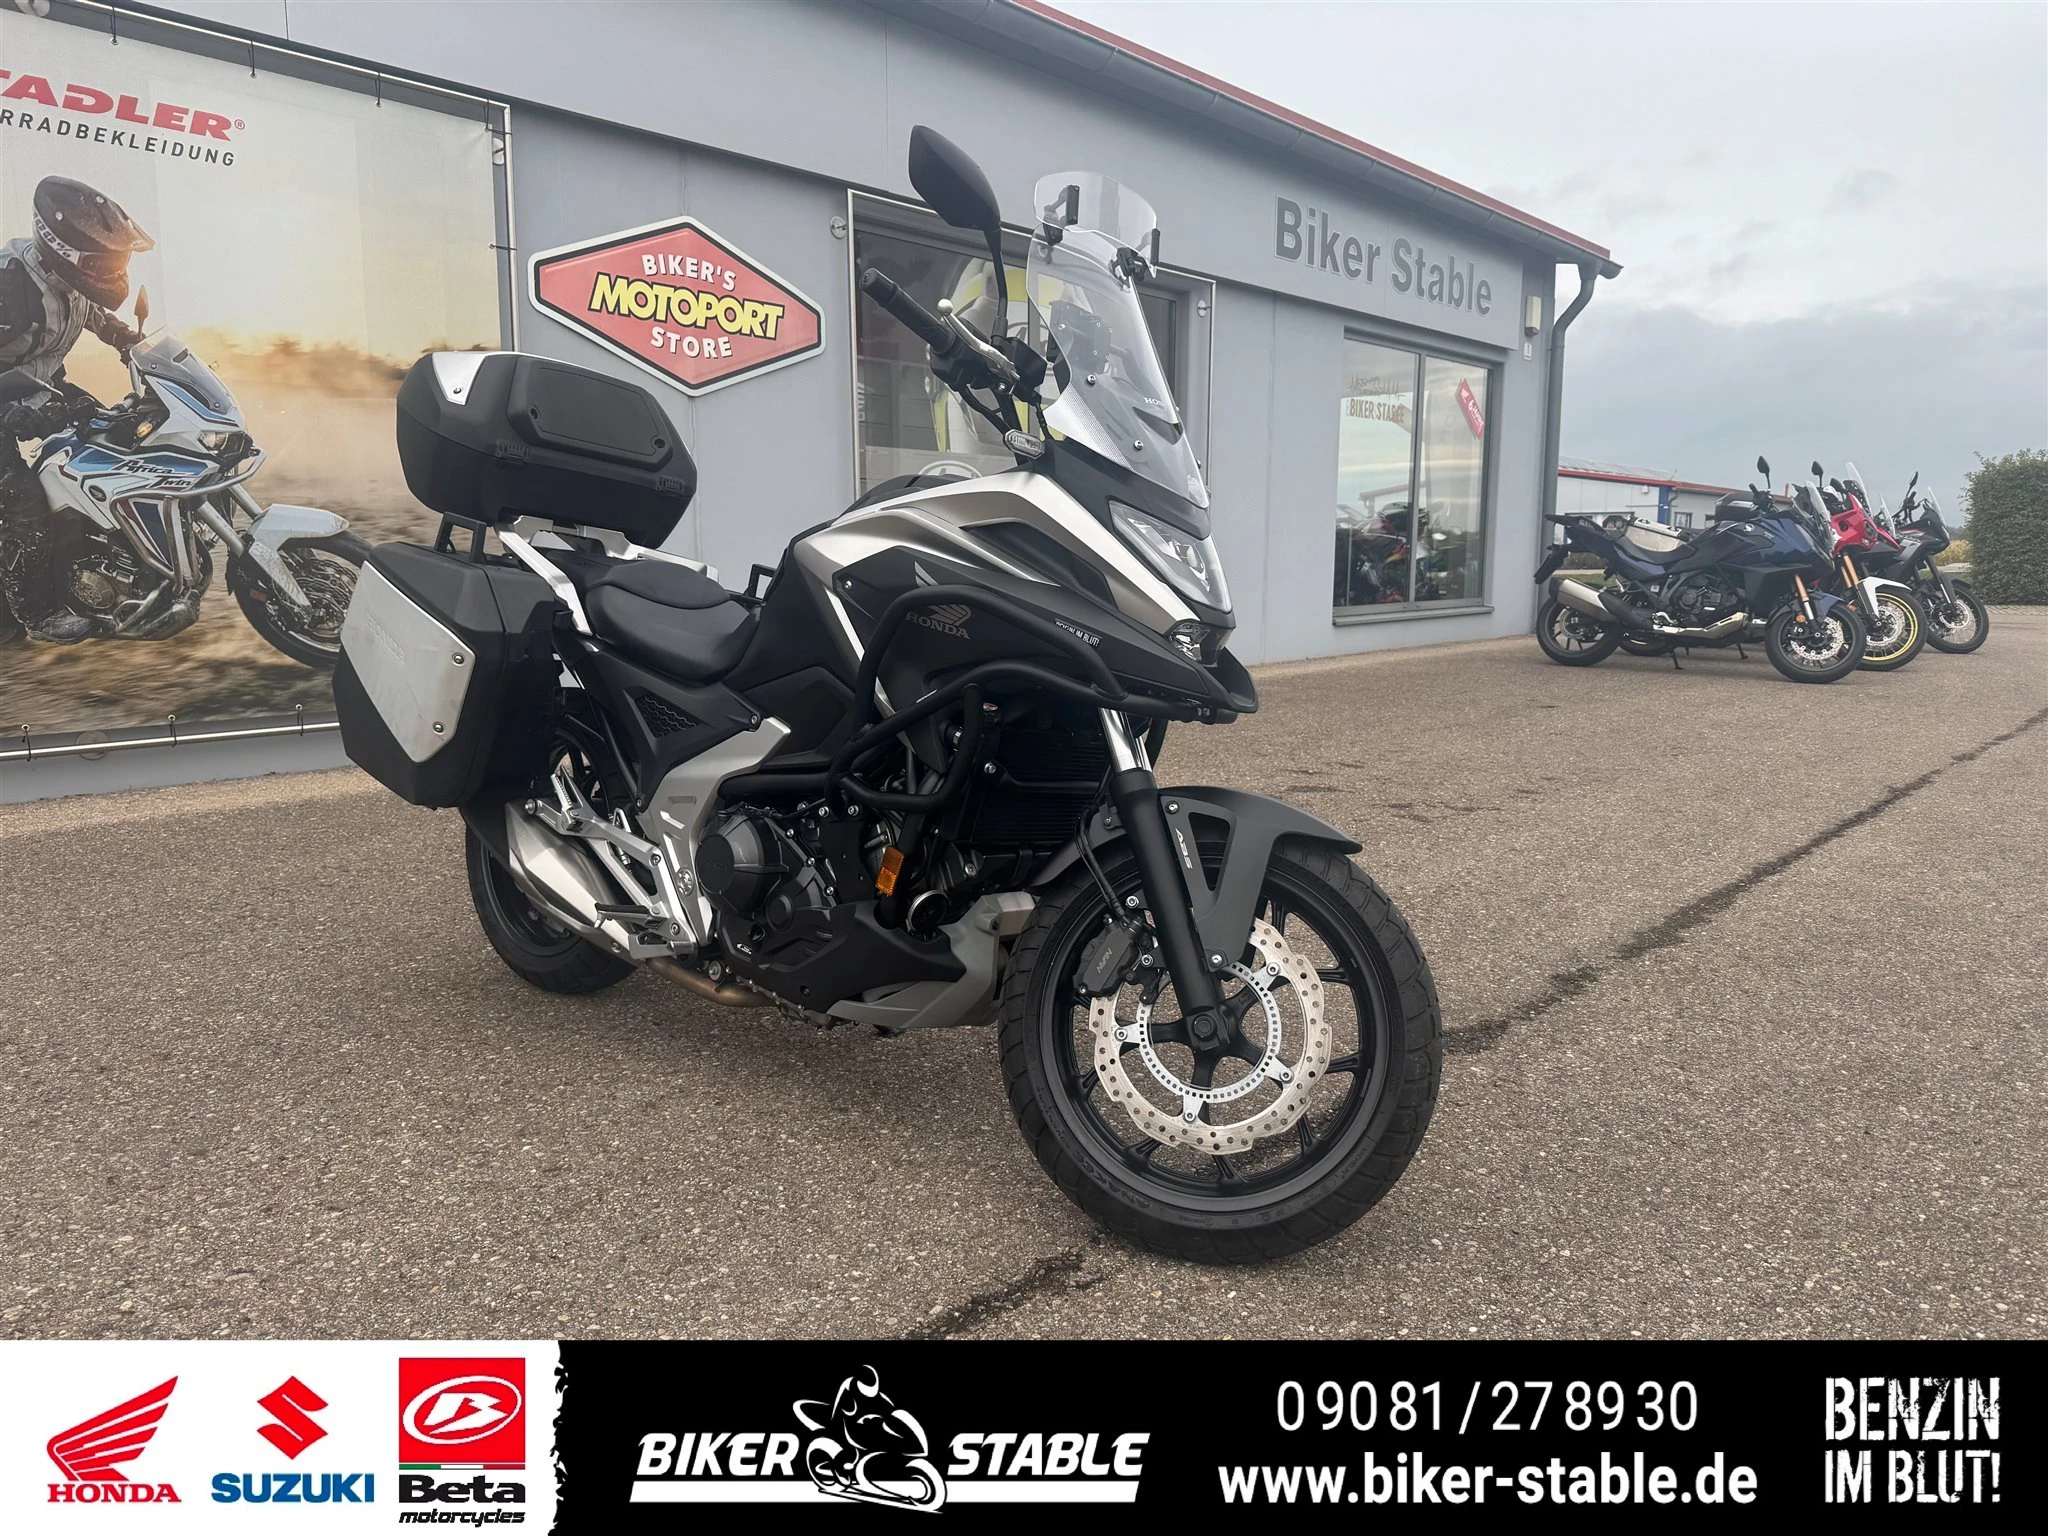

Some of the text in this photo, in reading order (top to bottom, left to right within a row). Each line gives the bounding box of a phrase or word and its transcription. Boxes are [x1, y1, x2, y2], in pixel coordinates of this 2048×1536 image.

[0, 109, 235, 167] RRADBEKLEIDUNG
[641, 253, 737, 291] BIKER'S
[1275, 196, 1492, 315] Biker Stable
[588, 272, 785, 340] MOTOPORT
[650, 326, 733, 359] STORE
[1350, 398, 1374, 420] BIKER
[905, 611, 970, 640] HONDA
